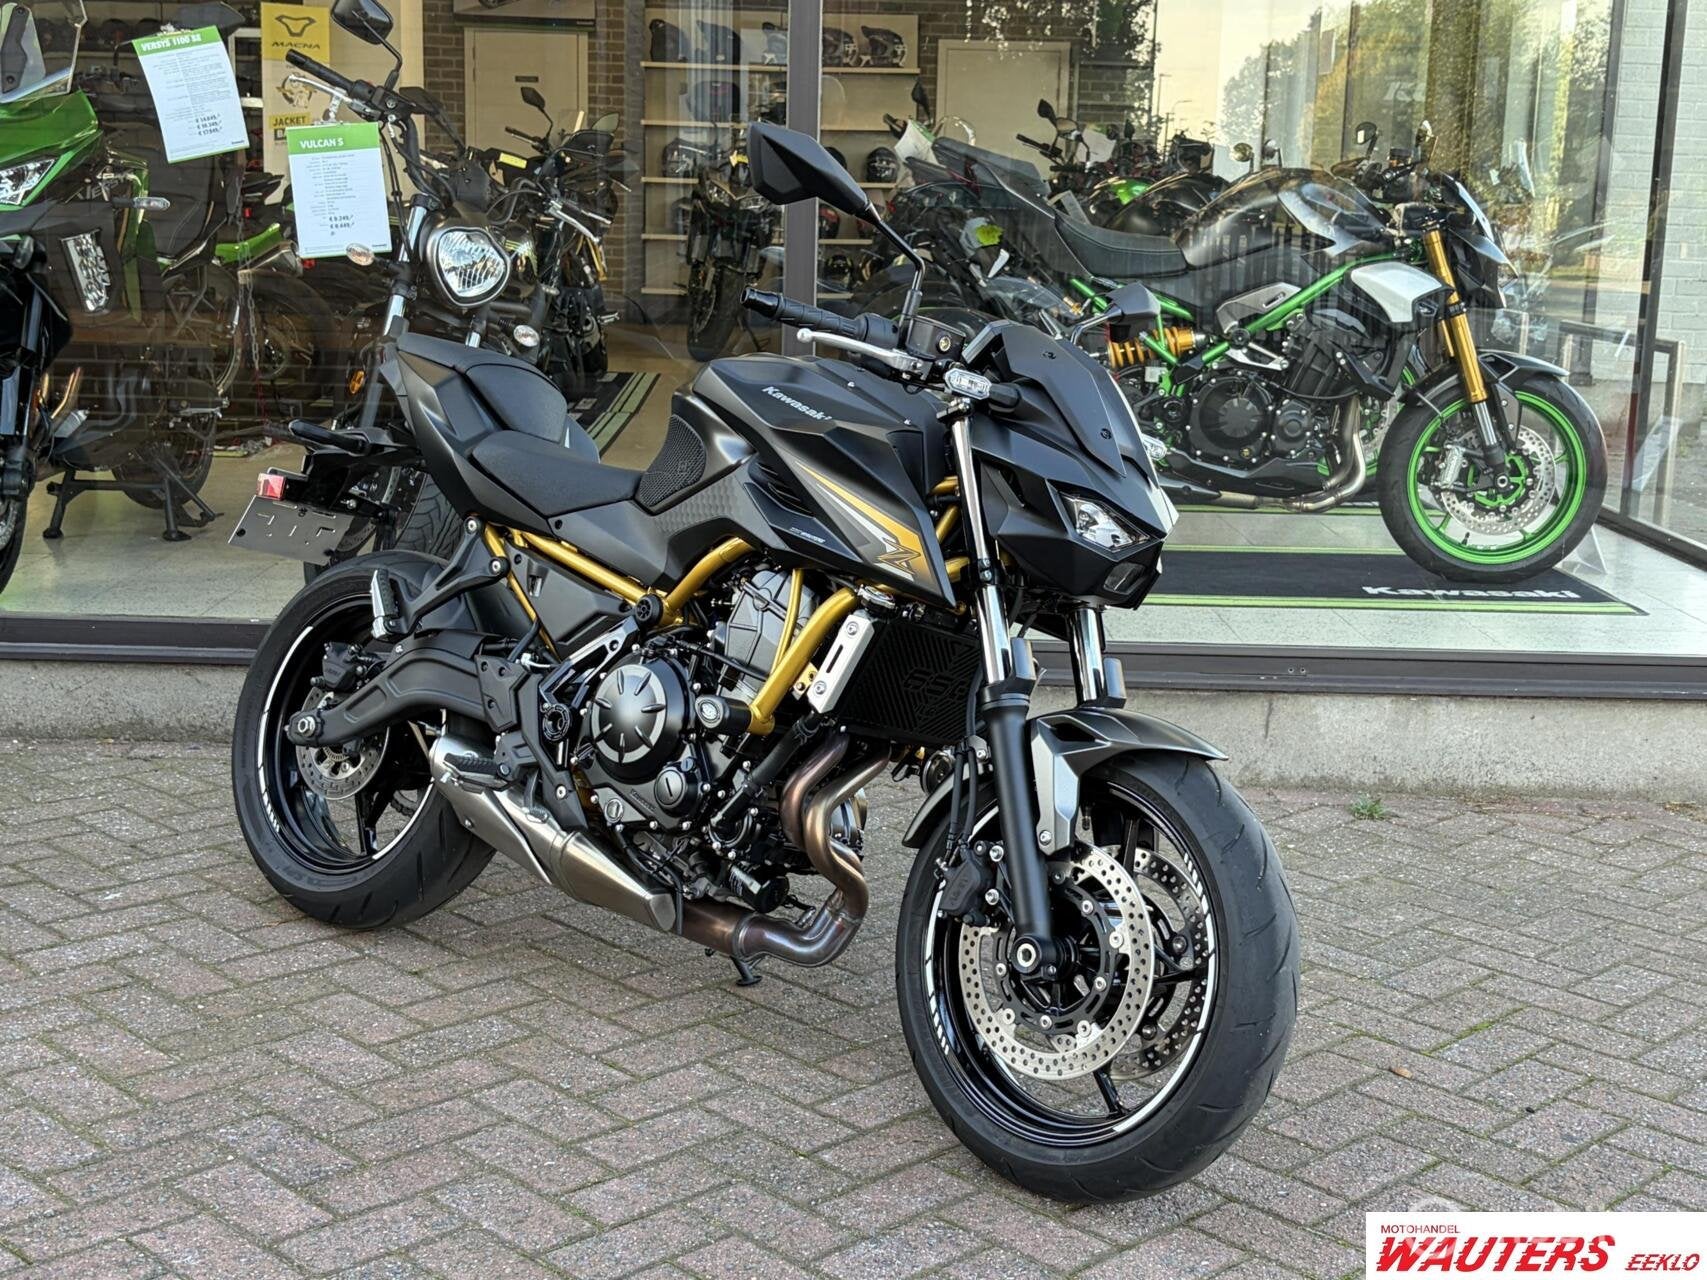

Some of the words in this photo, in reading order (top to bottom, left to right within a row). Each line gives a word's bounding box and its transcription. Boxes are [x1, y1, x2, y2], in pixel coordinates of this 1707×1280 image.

[173, 35, 191, 46] 1100
[271, 41, 321, 49] MACNA
[273, 115, 306, 127] JACKET
[300, 138, 336, 149] VULCAN
[337, 137, 344, 146] S
[761, 386, 833, 420] Kawasaki
[1362, 586, 1582, 599] Kawasaki
